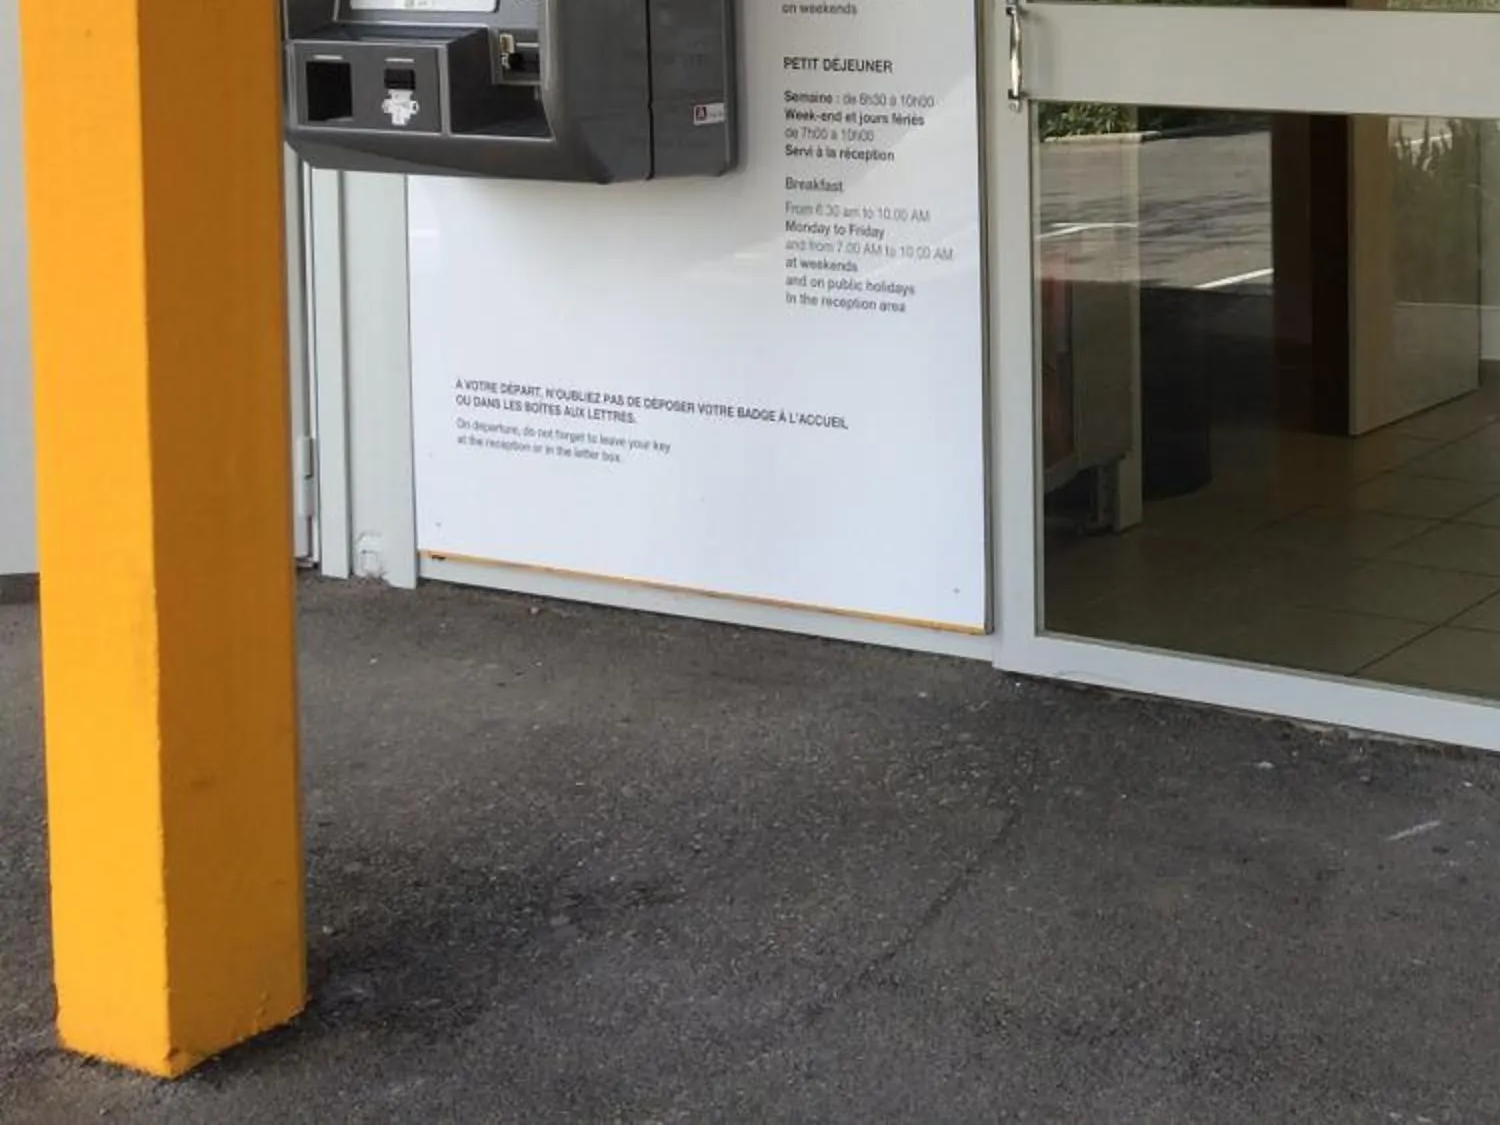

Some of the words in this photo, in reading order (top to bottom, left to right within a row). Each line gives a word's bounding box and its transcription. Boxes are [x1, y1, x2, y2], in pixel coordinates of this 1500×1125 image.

[781, 4, 796, 14] on
[799, 2, 857, 15] weekends
[783, 57, 819, 71] PETIT
[784, 90, 833, 105] Semaine
[842, 94, 857, 106] de
[859, 93, 887, 106] 6h30
[900, 95, 935, 108] 10h00
[784, 108, 842, 122] Week-end
[845, 110, 857, 122] et
[859, 111, 889, 125] jours
[785, 128, 798, 140] de
[785, 145, 812, 157] Servi
[815, 145, 823, 157] à
[825, 146, 837, 158] la
[785, 177, 844, 192] Breakfast
[785, 201, 813, 216] From
[862, 207, 874, 219] to
[911, 209, 931, 222] AM
[785, 221, 831, 236] Monday
[833, 222, 845, 235] to
[849, 223, 885, 240] Friday
[785, 239, 806, 252] and
[808, 239, 834, 253] from
[863, 242, 883, 256] AM
[885, 243, 897, 257] to
[933, 246, 954, 261] AM
[785, 257, 797, 268] at
[800, 258, 858, 272] weekends
[785, 274, 807, 287] and
[810, 277, 825, 288] on
[827, 277, 863, 291] public
[865, 280, 915, 297] holidays
[800, 293, 818, 305] the
[821, 294, 876, 311] reception
[879, 302, 906, 312] area
[456, 394, 471, 406] OU
[473, 396, 501, 409] DANS
[503, 399, 522, 412] LES
[564, 405, 585, 418] AUX
[464, 379, 497, 394] VOTRE
[603, 394, 625, 406] PAS
[627, 396, 641, 408] DE
[697, 403, 734, 418] VOTRE
[737, 406, 776, 422] BADGE
[456, 417, 470, 429] On
[523, 425, 535, 437] do
[538, 427, 553, 439] not
[555, 428, 585, 444] forget
[587, 431, 598, 443] to
[600, 433, 626, 447] leave
[629, 438, 651, 450] your
[653, 440, 670, 454] key
[457, 435, 467, 444] at
[469, 435, 483, 446] the
[485, 437, 531, 452] reception
[533, 443, 543, 453] or
[545, 444, 555, 455] in
[556, 445, 571, 457] the
[573, 448, 599, 460] letter
